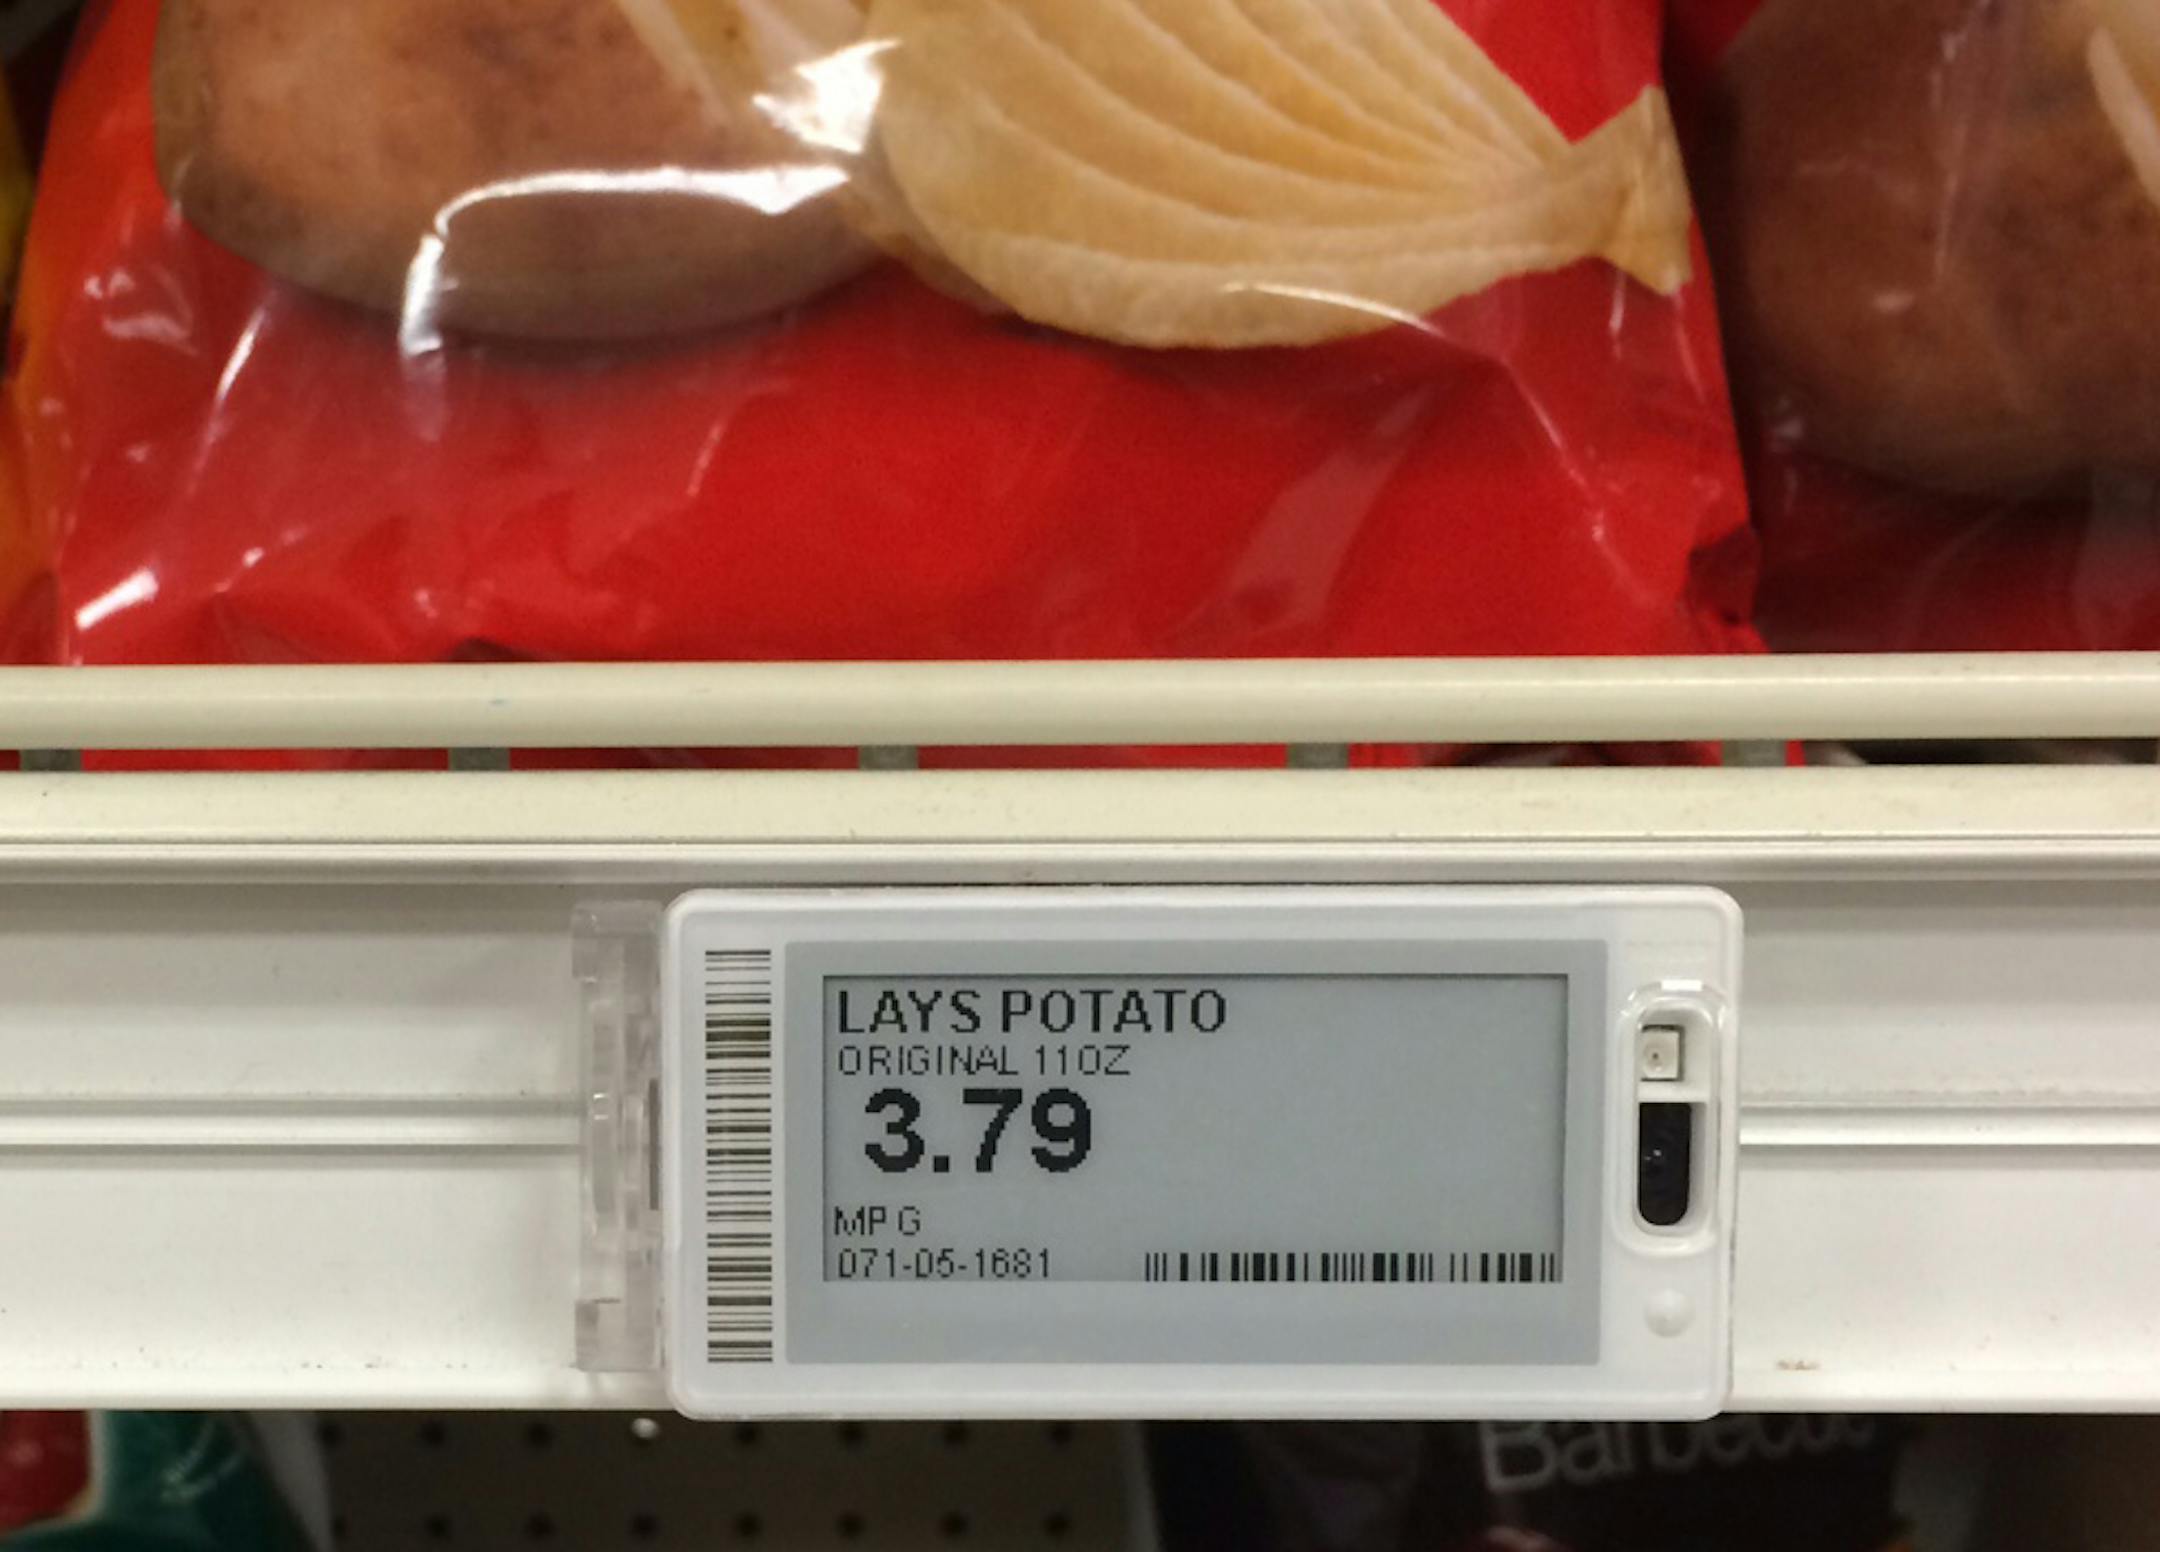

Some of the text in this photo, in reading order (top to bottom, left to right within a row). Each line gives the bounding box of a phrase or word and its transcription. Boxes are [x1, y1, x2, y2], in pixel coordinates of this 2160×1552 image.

[838, 989, 1227, 1033] LAYS POTATO
[838, 1044, 1020, 1076] ORIGINAL
[864, 1087, 1092, 1173] 3.79
[838, 1247, 1050, 1279] 071-05-1681
